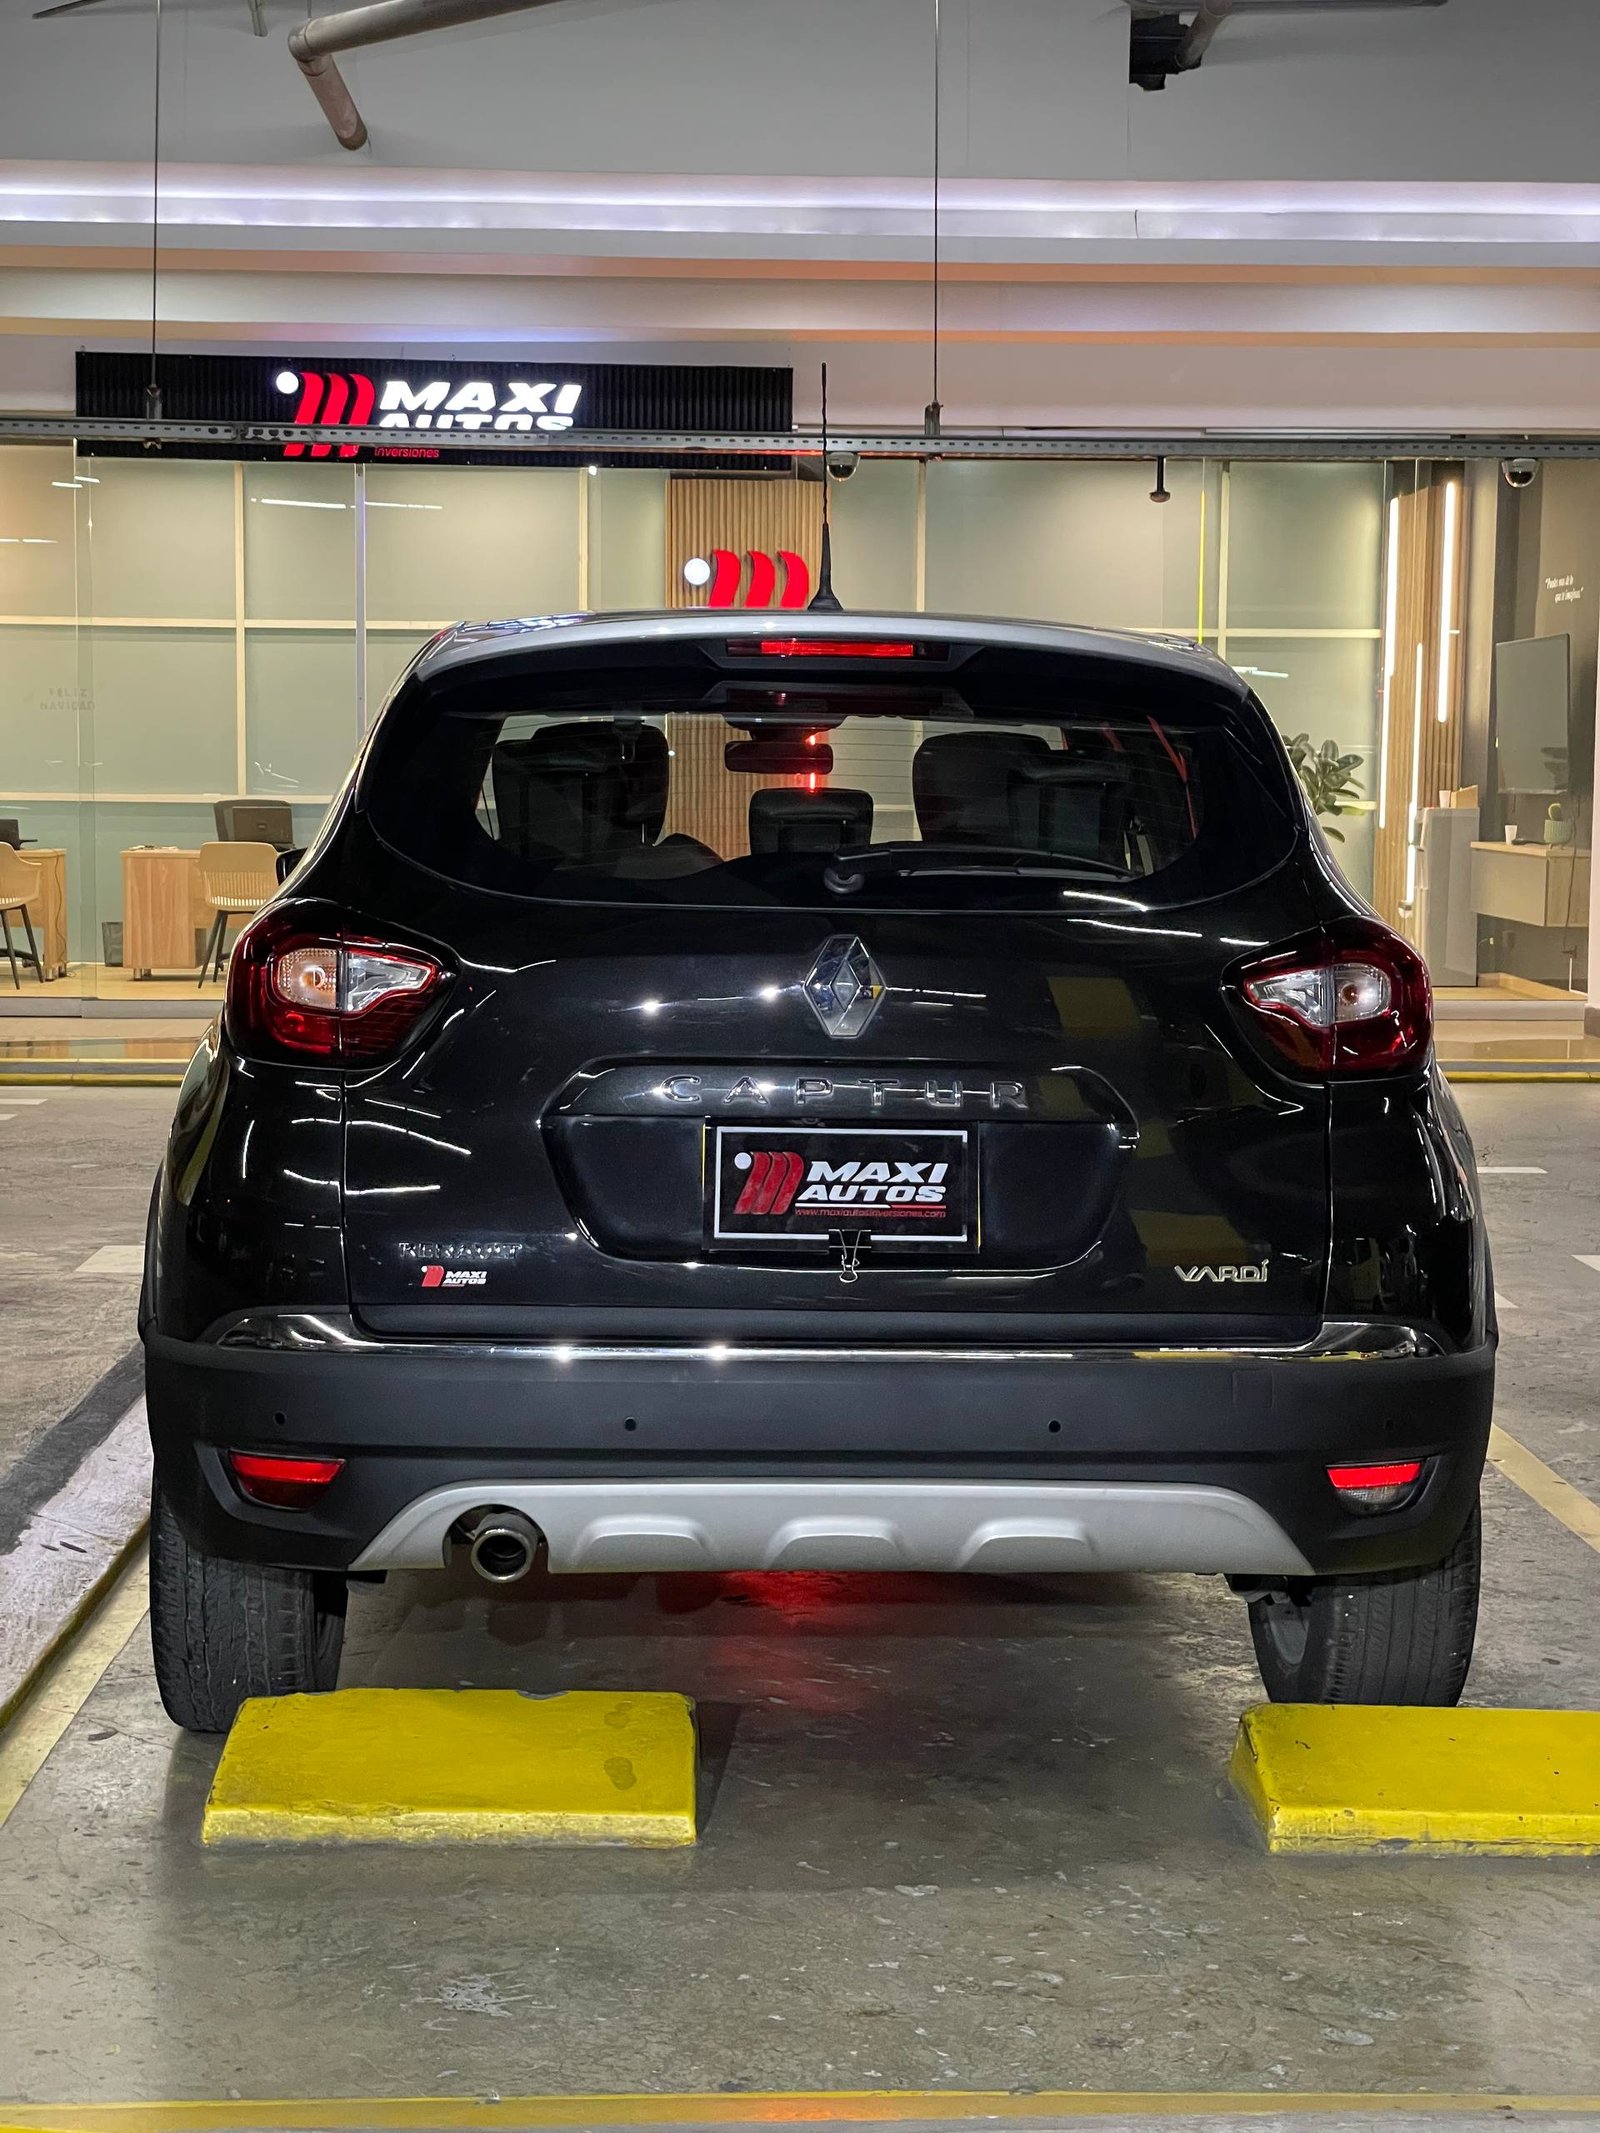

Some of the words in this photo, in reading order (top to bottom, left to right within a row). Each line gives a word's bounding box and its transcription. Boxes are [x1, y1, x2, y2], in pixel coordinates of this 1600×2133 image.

[379, 380, 583, 414] MAXI
[659, 1074, 1030, 1109] CAPTUR
[806, 1160, 949, 1184] MAXI
[797, 1184, 947, 1203] AUTOS
[795, 1207, 946, 1218] www.maxiautosinversiones.com
[399, 1242, 523, 1259] RENAULT
[445, 1270, 488, 1279] MAXI
